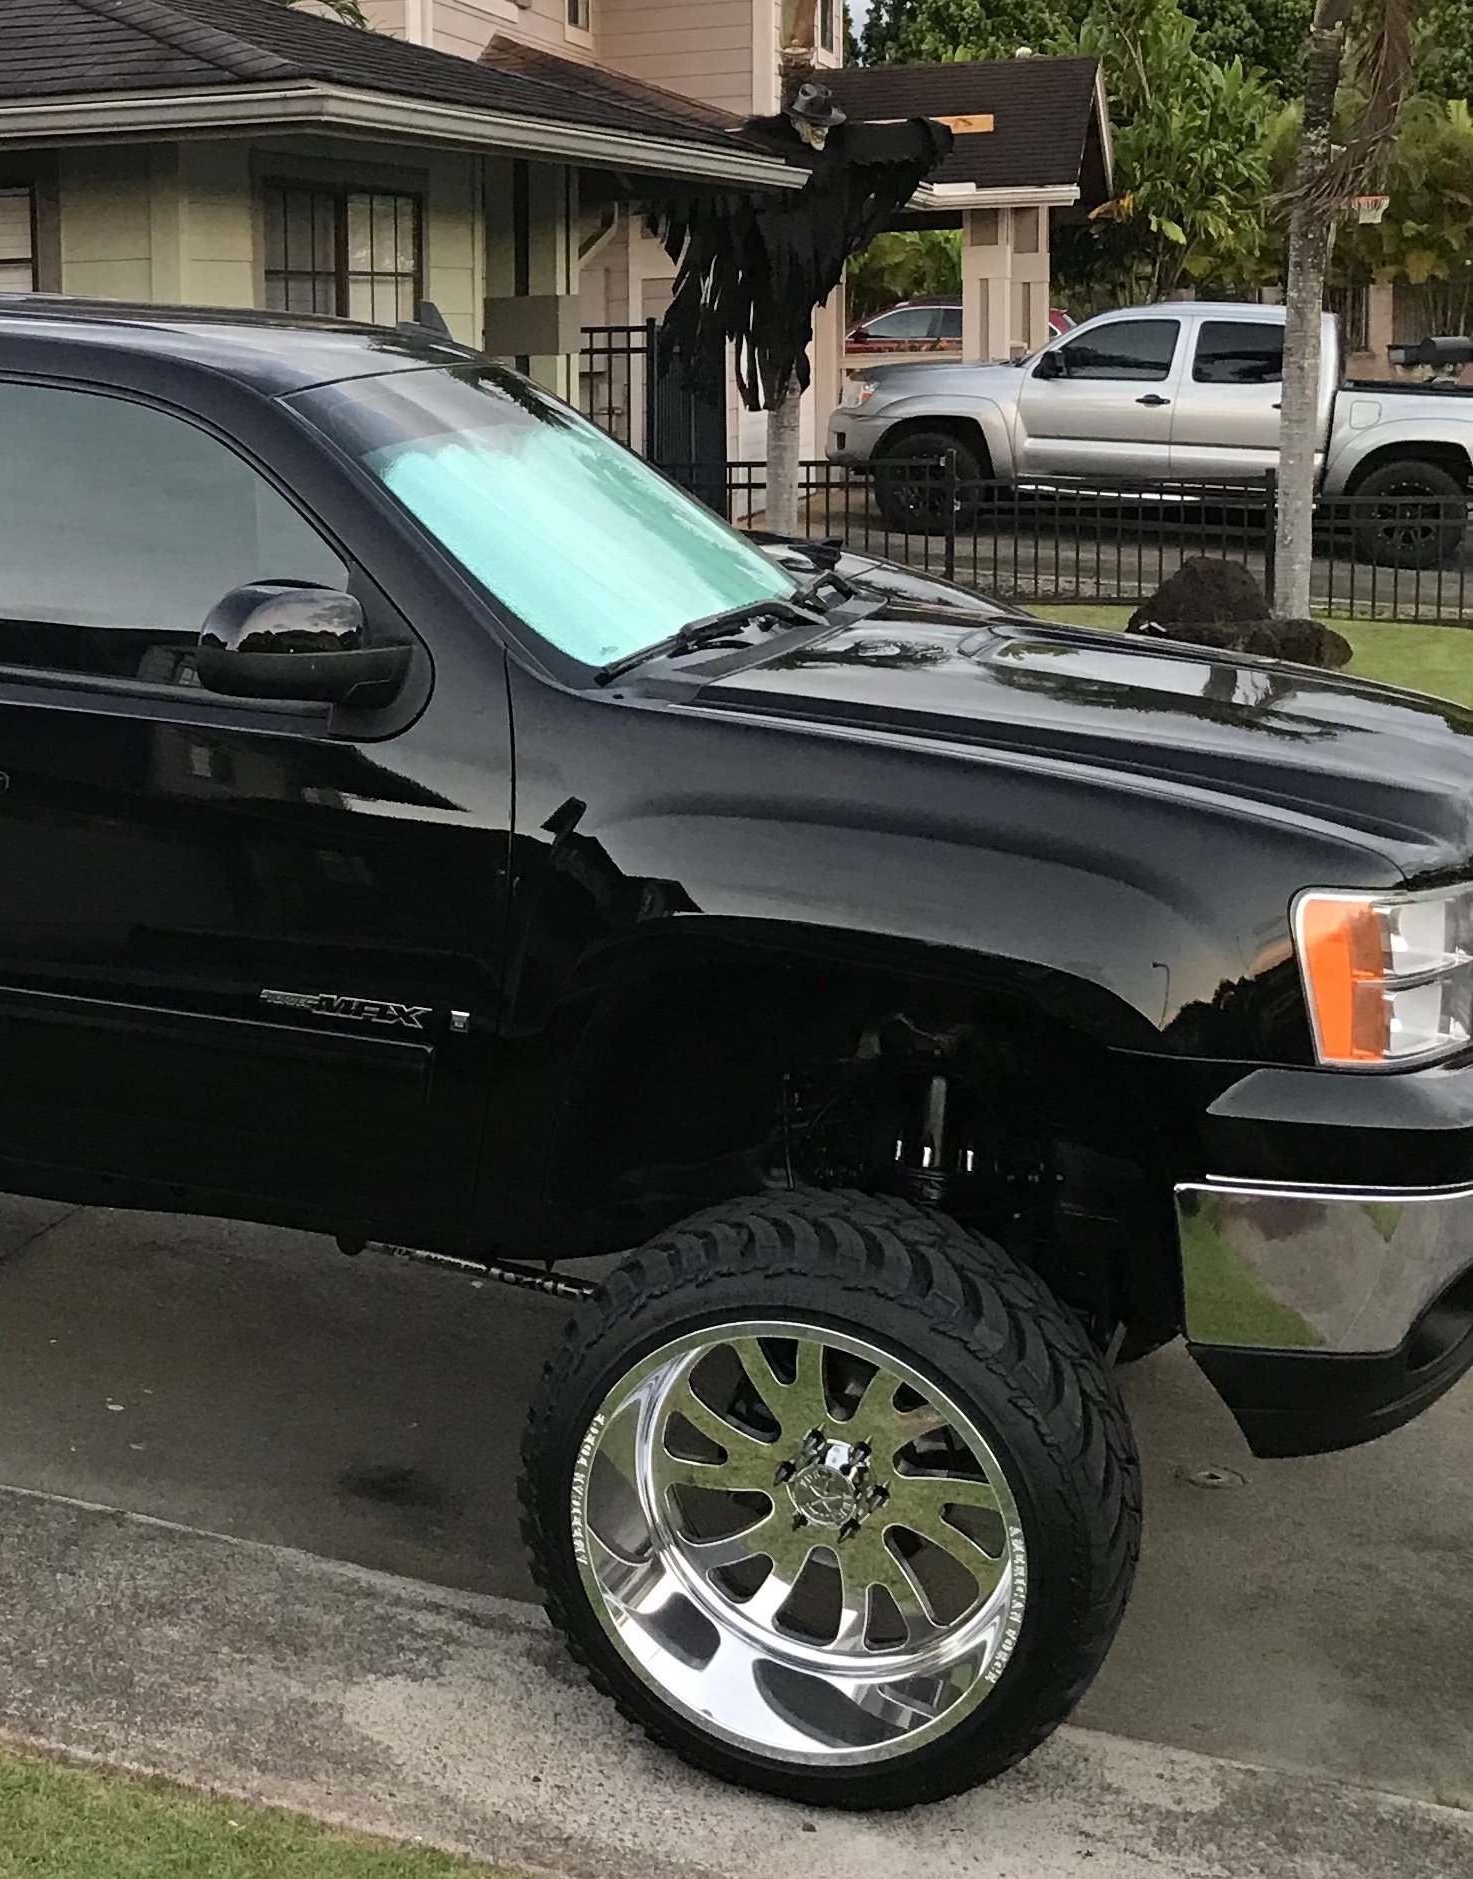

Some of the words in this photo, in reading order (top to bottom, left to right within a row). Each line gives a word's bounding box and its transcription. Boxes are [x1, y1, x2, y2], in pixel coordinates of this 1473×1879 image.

[576, 1413, 606, 1467] FORCE
[571, 1471, 589, 1565] AMERICAN
[1008, 1525, 1026, 1624] AMERICAN
[984, 1628, 1018, 1684] FORCE
